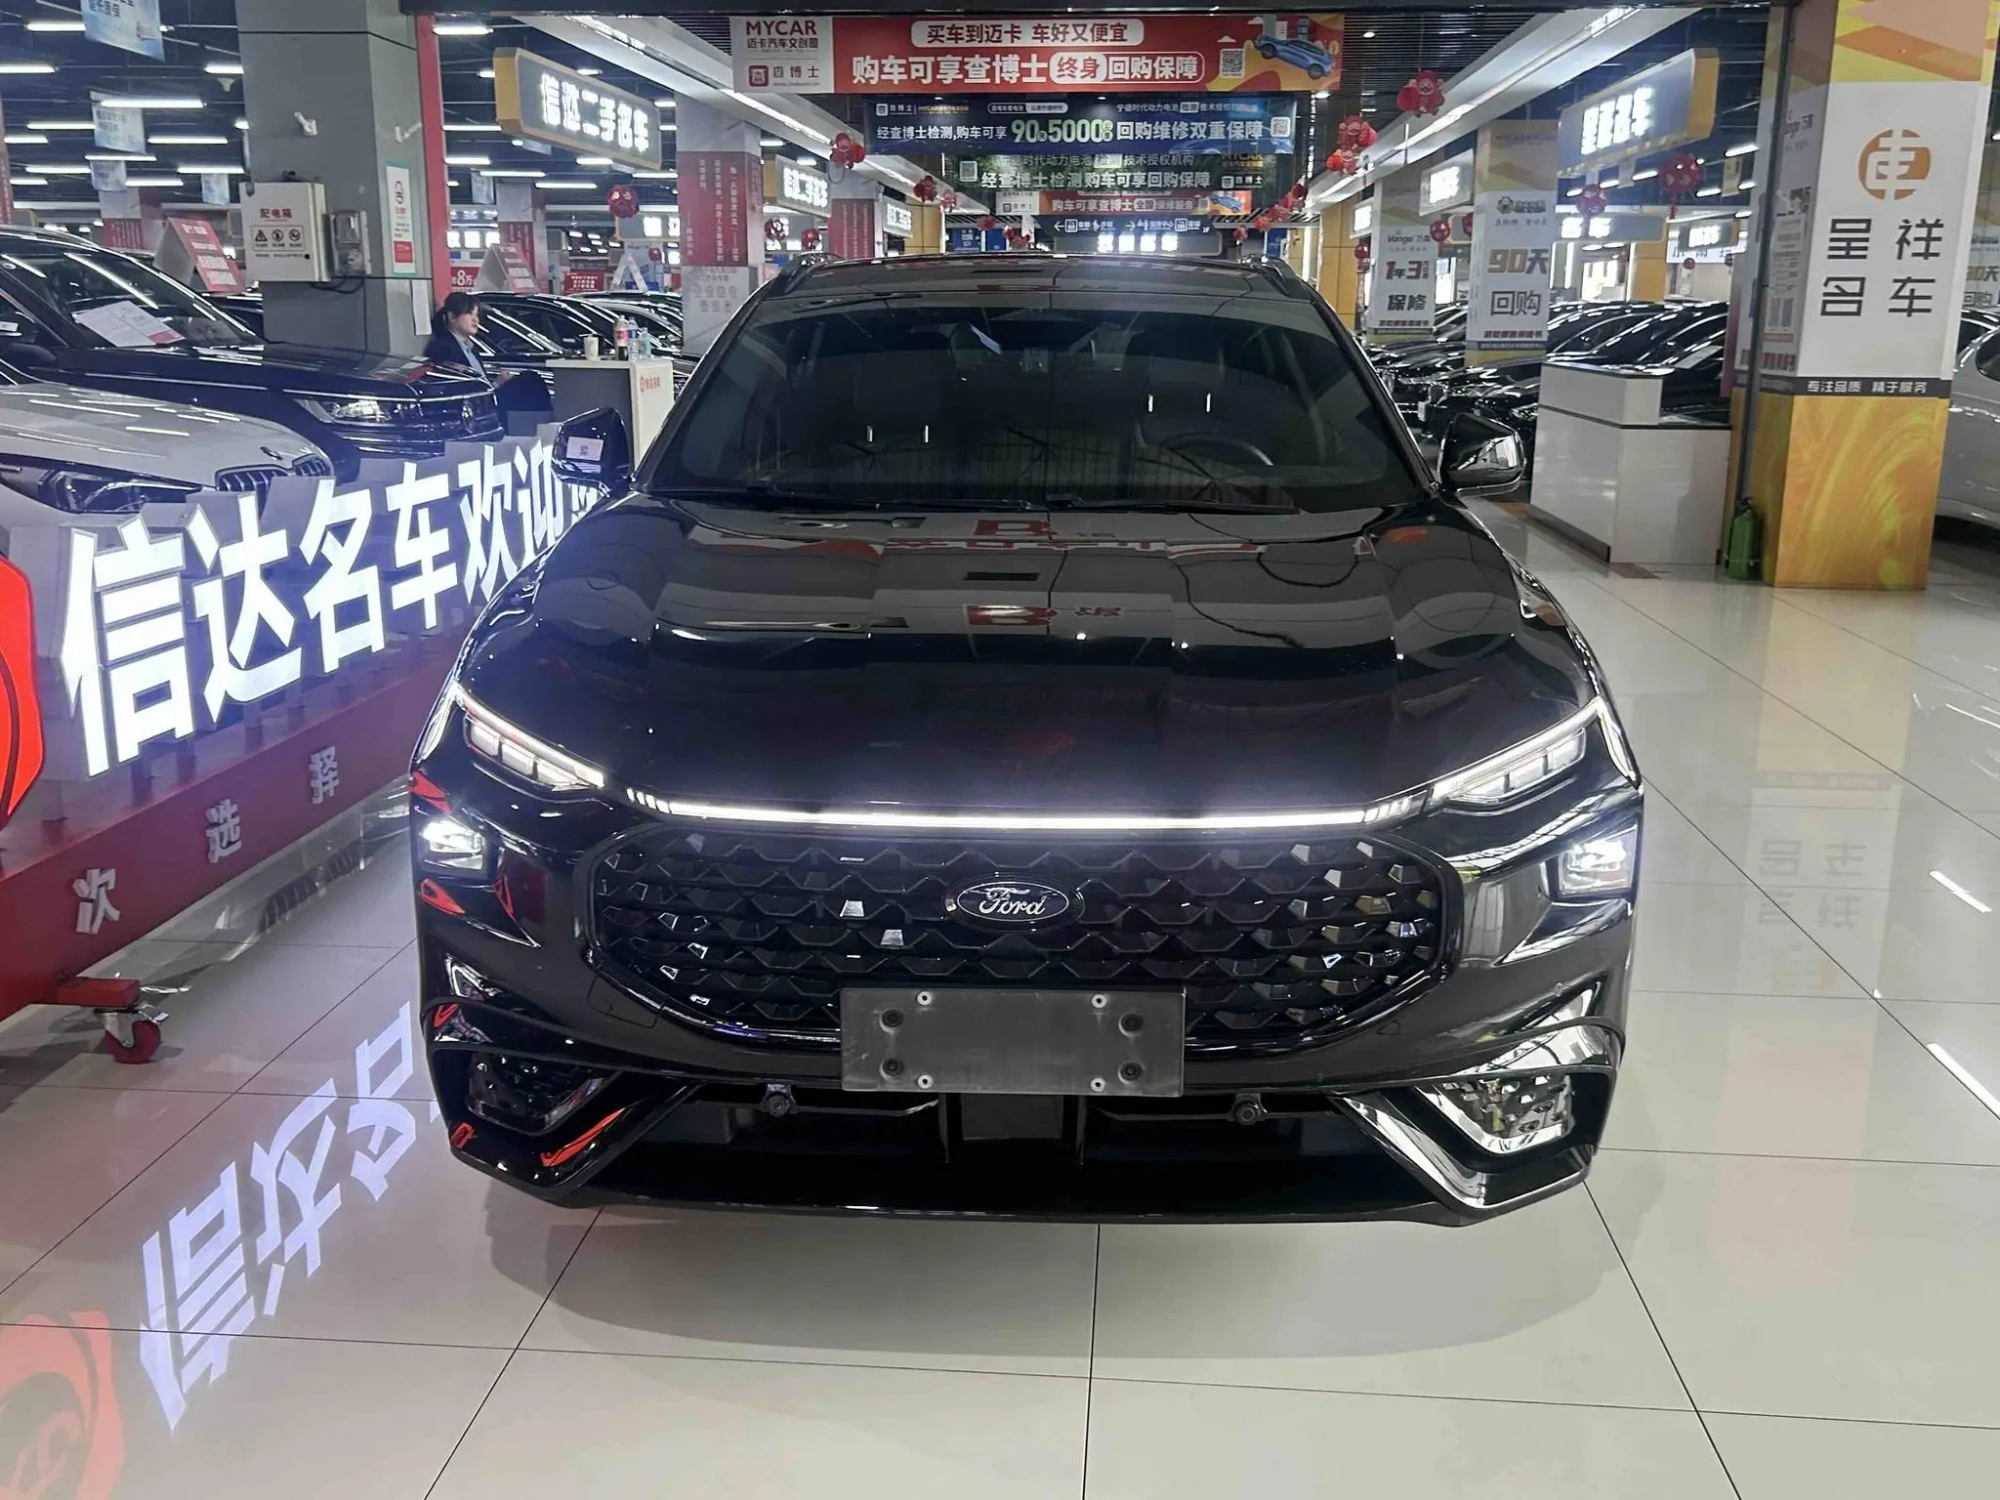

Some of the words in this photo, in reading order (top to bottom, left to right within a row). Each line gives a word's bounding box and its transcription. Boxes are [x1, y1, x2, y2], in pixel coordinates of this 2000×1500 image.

[746, 20, 817, 36] MYCAR
[926, 25, 1023, 44] 买车到迈卡
[1032, 24, 1129, 43] 车好又便宜
[1487, 248, 1549, 274] 90天
[1491, 290, 1542, 316] 回购
[979, 886, 1047, 916] Ford
